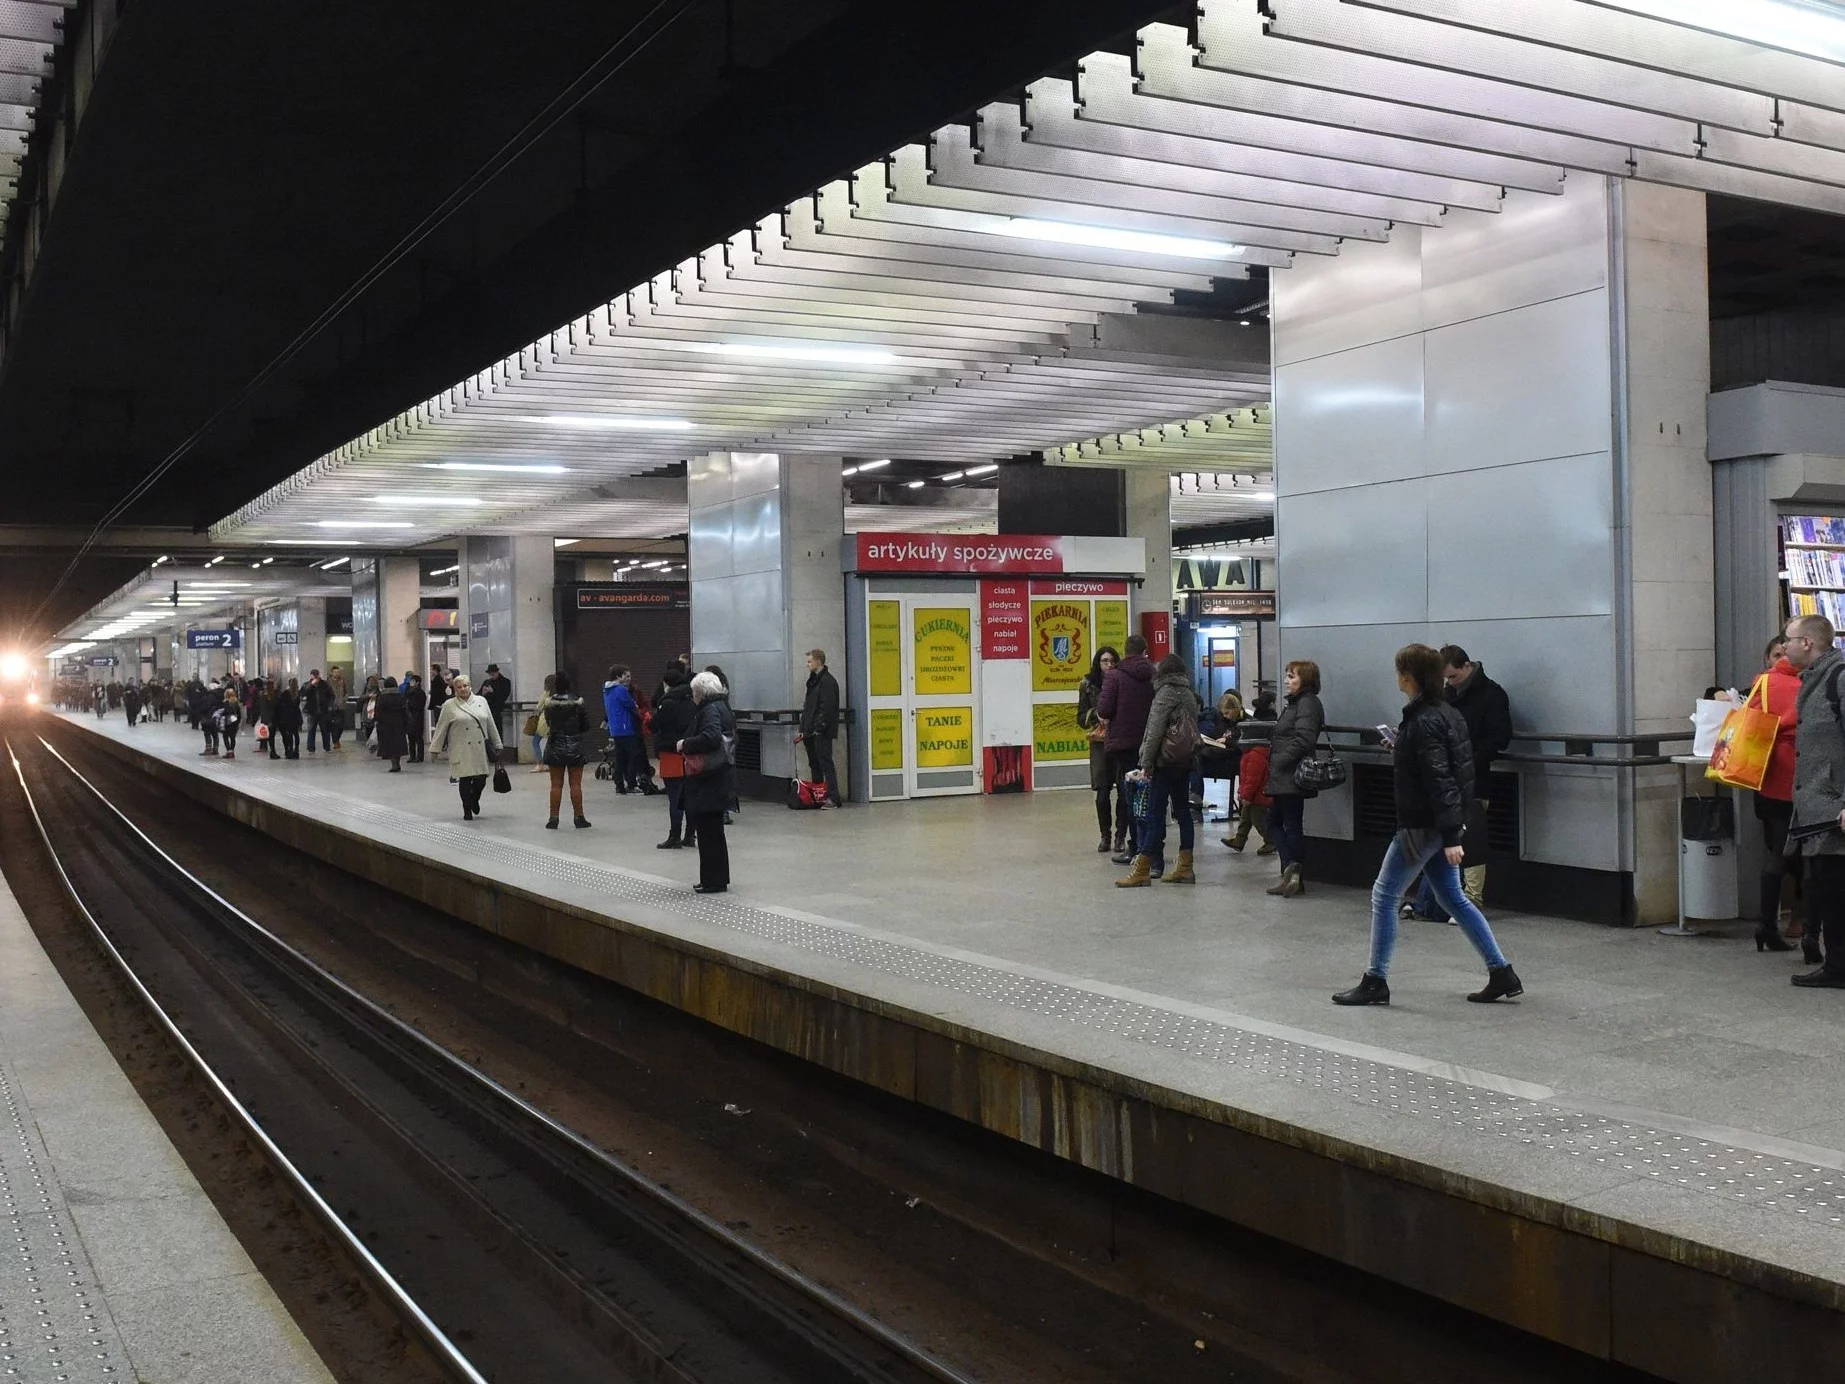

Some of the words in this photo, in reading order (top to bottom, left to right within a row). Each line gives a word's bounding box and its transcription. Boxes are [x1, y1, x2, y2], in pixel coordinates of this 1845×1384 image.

[868, 541, 947, 562] artykuły
[953, 543, 1053, 563] spożywcze
[993, 586, 1016, 595] ciasta
[1055, 582, 1104, 593] pieczywo
[599, 593, 670, 604] avangarda.com
[988, 601, 1021, 610] słodycze
[987, 615, 1023, 625] pieczywo
[1034, 605, 1088, 629] PIEKARNIA
[341, 621, 354, 629] WC
[915, 618, 969, 645] CUKIERNIA
[993, 629, 1017, 638] nabiał
[195, 634, 220, 642] peron
[222, 634, 232, 647] 2
[993, 643, 1019, 654] napoje
[926, 715, 962, 727] TANIE
[919, 739, 969, 751] NAPOJE
